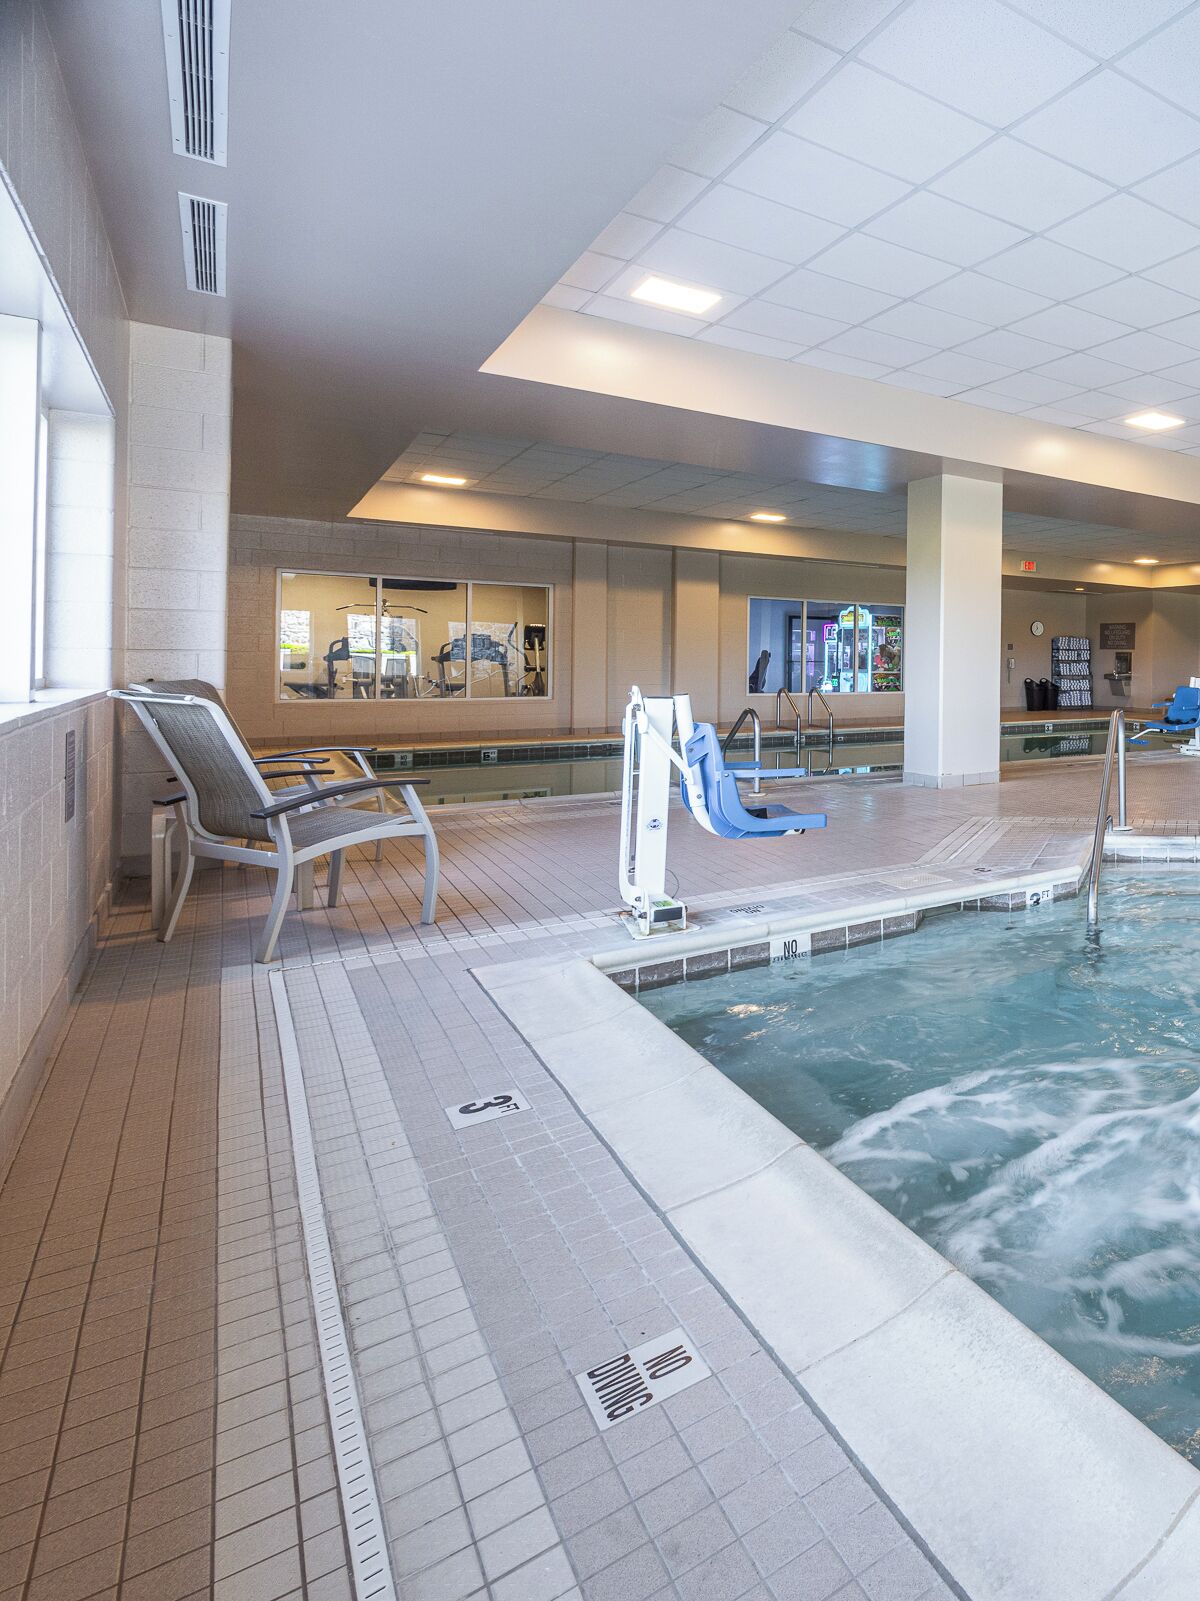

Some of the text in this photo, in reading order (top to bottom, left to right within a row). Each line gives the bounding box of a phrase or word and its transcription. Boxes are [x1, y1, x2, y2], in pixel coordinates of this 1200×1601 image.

[1041, 890, 1050, 899] FT
[783, 939, 798, 957] NO
[458, 1095, 521, 1114] 3 FT
[643, 1344, 693, 1380] NO
[586, 1353, 654, 1422] DIVING
